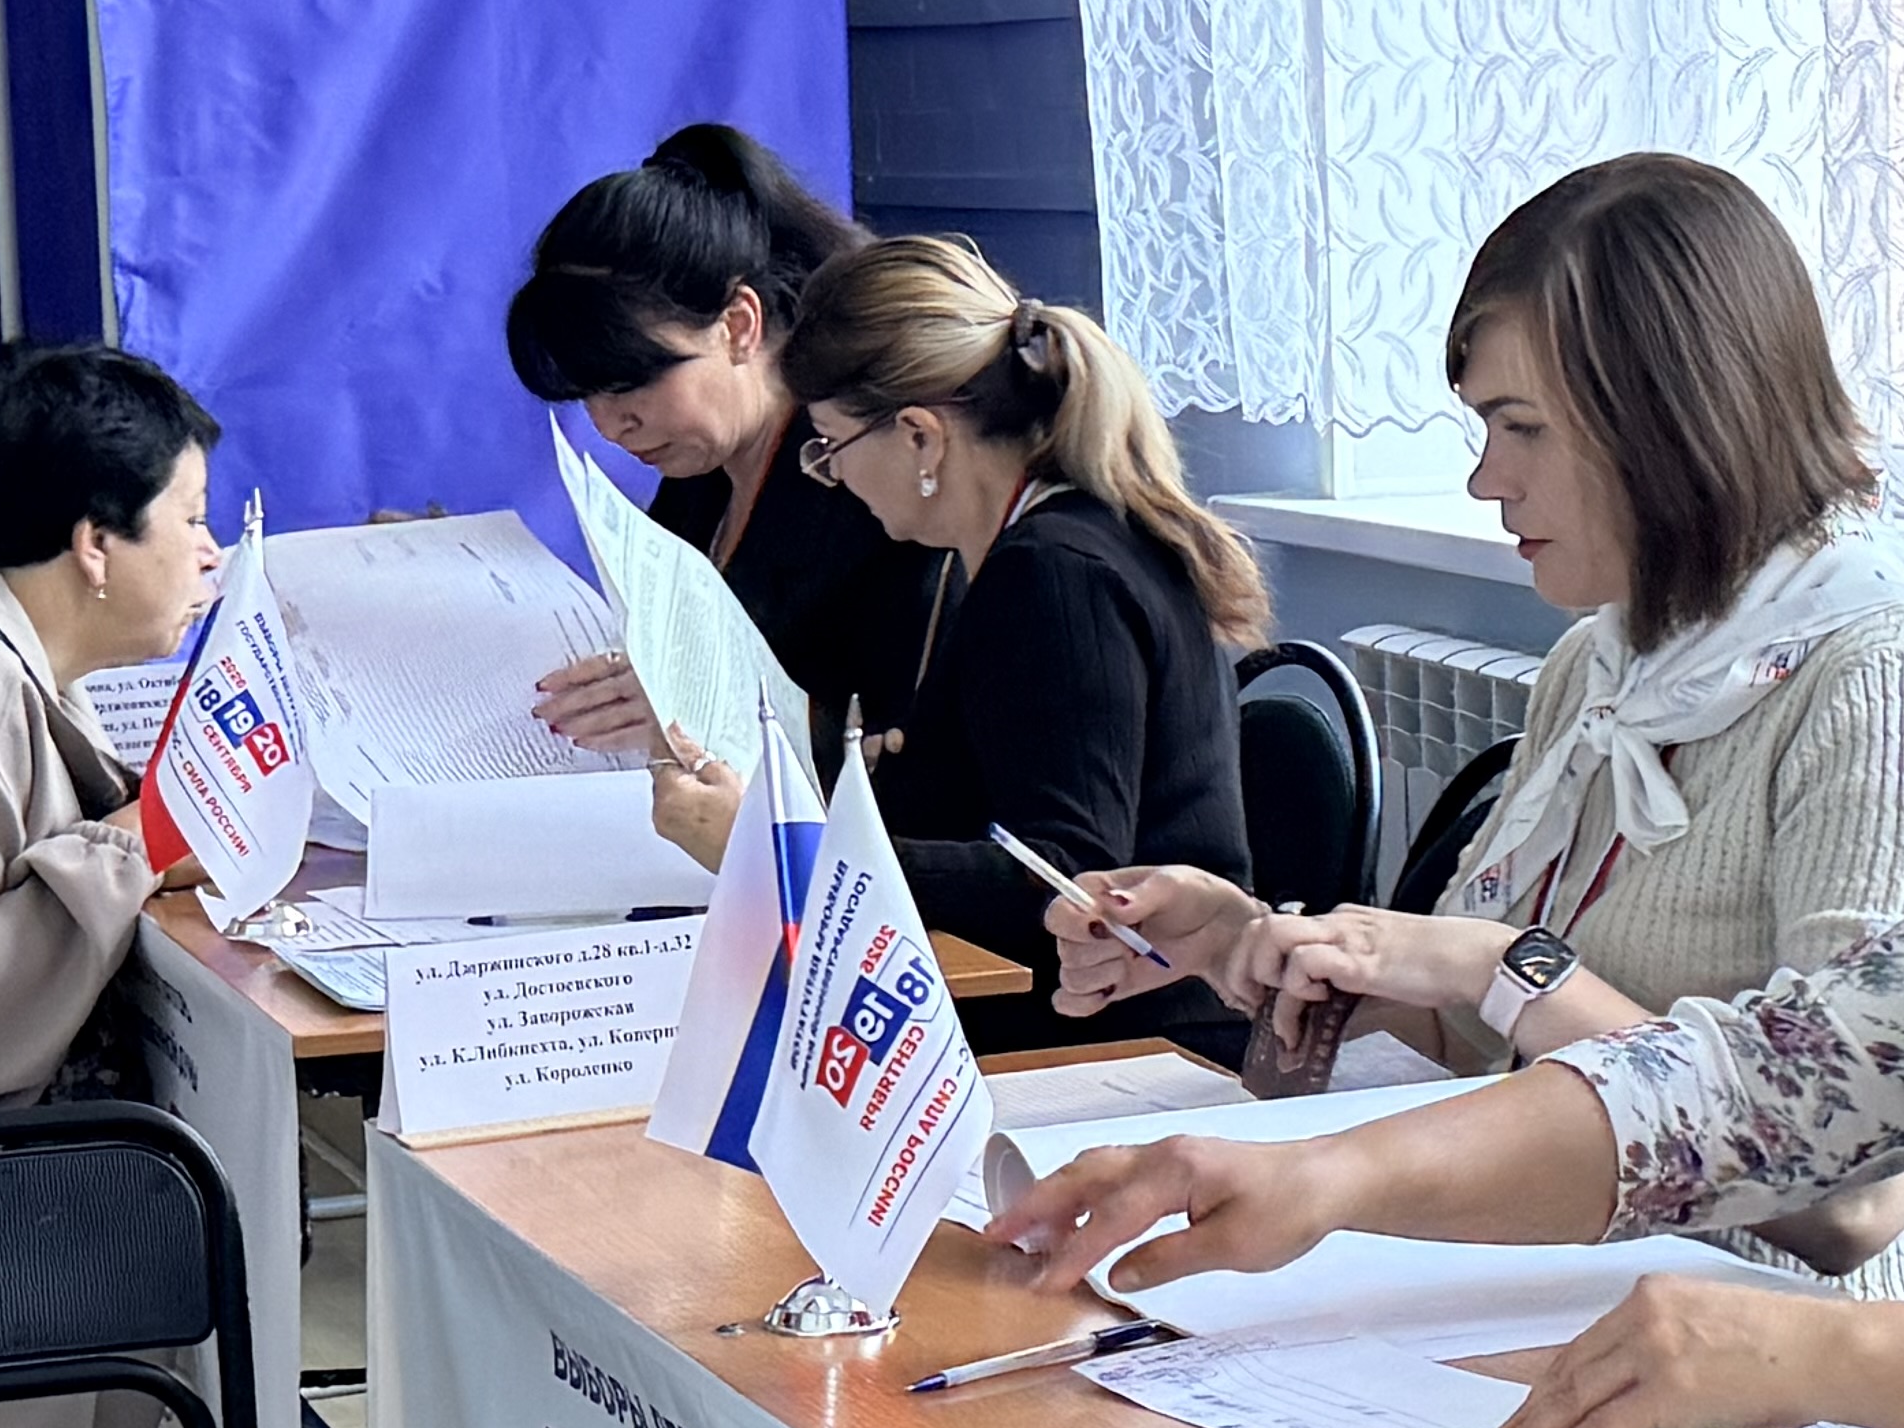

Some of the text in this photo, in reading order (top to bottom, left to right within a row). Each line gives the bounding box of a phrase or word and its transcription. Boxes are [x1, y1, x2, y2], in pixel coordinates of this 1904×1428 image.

[194, 678, 282, 768] 18 19 20
[202, 723, 252, 793] СЕНТЯБРЯ
[182, 761, 250, 857] СИЛА РОССИИ!
[415, 965, 443, 985] ул.
[446, 952, 573, 980] Дзержинского
[483, 973, 634, 1006] ул. Достоевского
[487, 1017, 514, 1035] ул.
[419, 1053, 447, 1072] ул.
[577, 1036, 604, 1054] ул.
[504, 1059, 634, 1092] ул. Короленко
